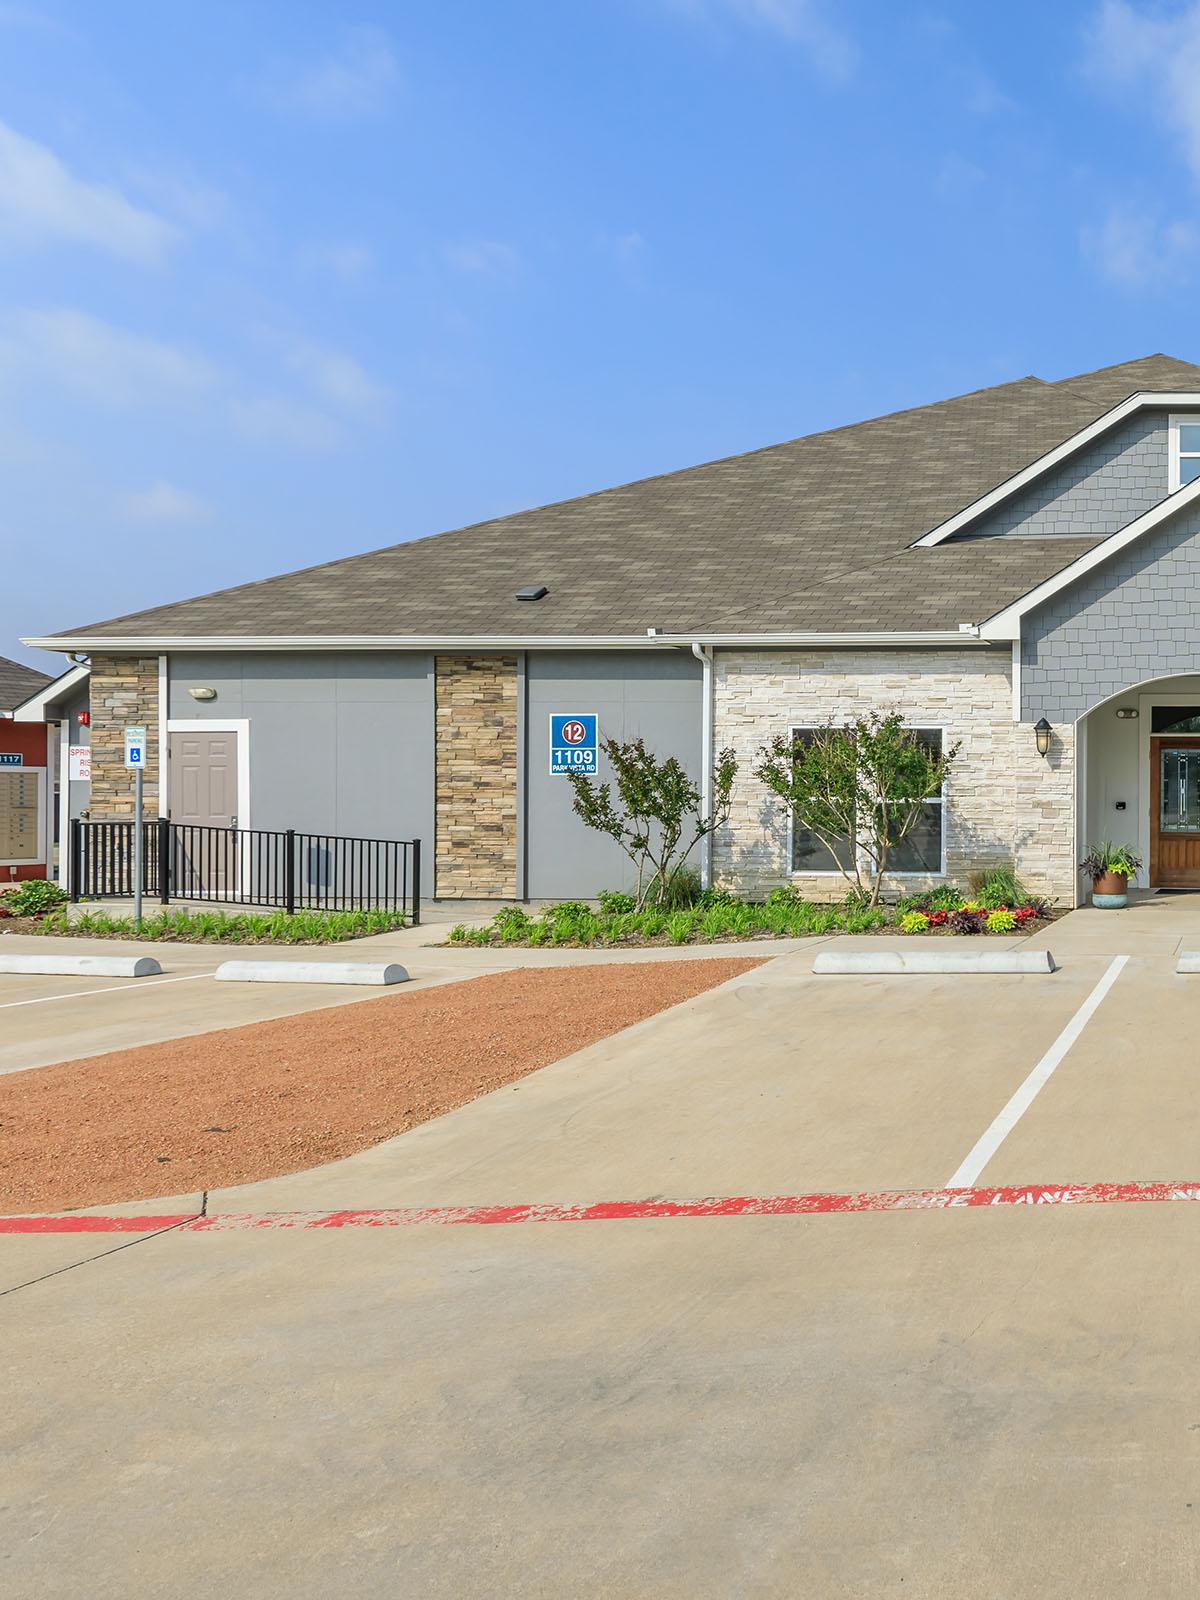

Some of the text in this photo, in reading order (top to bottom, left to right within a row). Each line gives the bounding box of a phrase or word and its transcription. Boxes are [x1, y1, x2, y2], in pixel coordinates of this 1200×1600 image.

[565, 724, 583, 740] 12
[555, 750, 593, 764] 1109
[990, 1190, 1083, 1206] LANE
